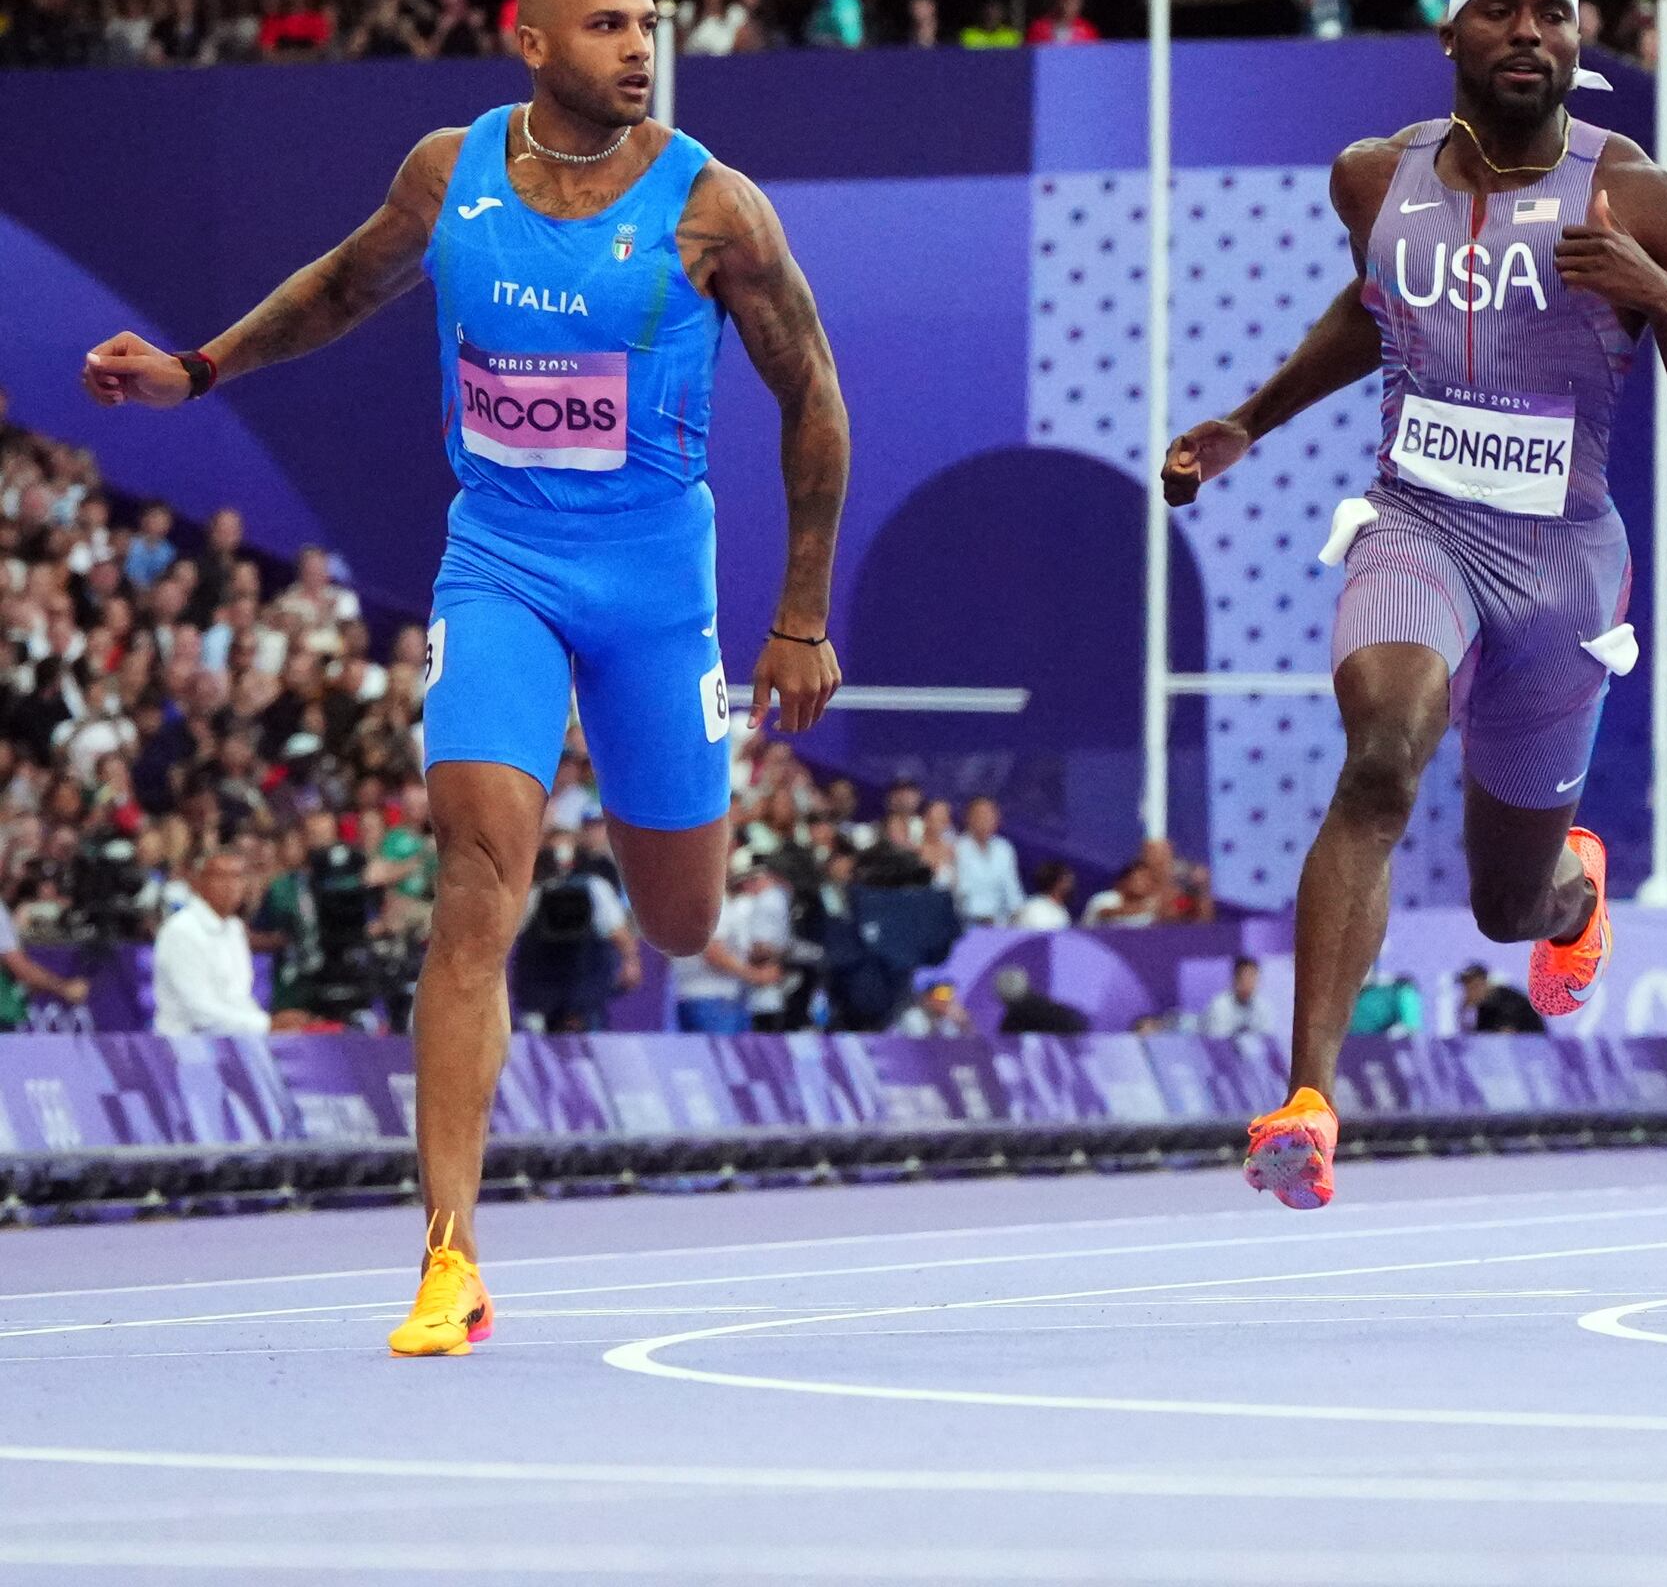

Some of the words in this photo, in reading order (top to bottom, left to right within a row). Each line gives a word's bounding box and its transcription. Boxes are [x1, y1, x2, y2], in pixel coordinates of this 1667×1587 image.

[1396, 238, 1548, 312] USA
[493, 280, 589, 317] ITALIA
[489, 357, 533, 371] PARIS
[539, 359, 579, 372] 2024
[464, 379, 617, 432] JACOBS
[1446, 387, 1486, 404] PARIS
[1491, 392, 1531, 410] 2024
[1402, 418, 1566, 476] BEDNAREK
[716, 677, 726, 720] 8
